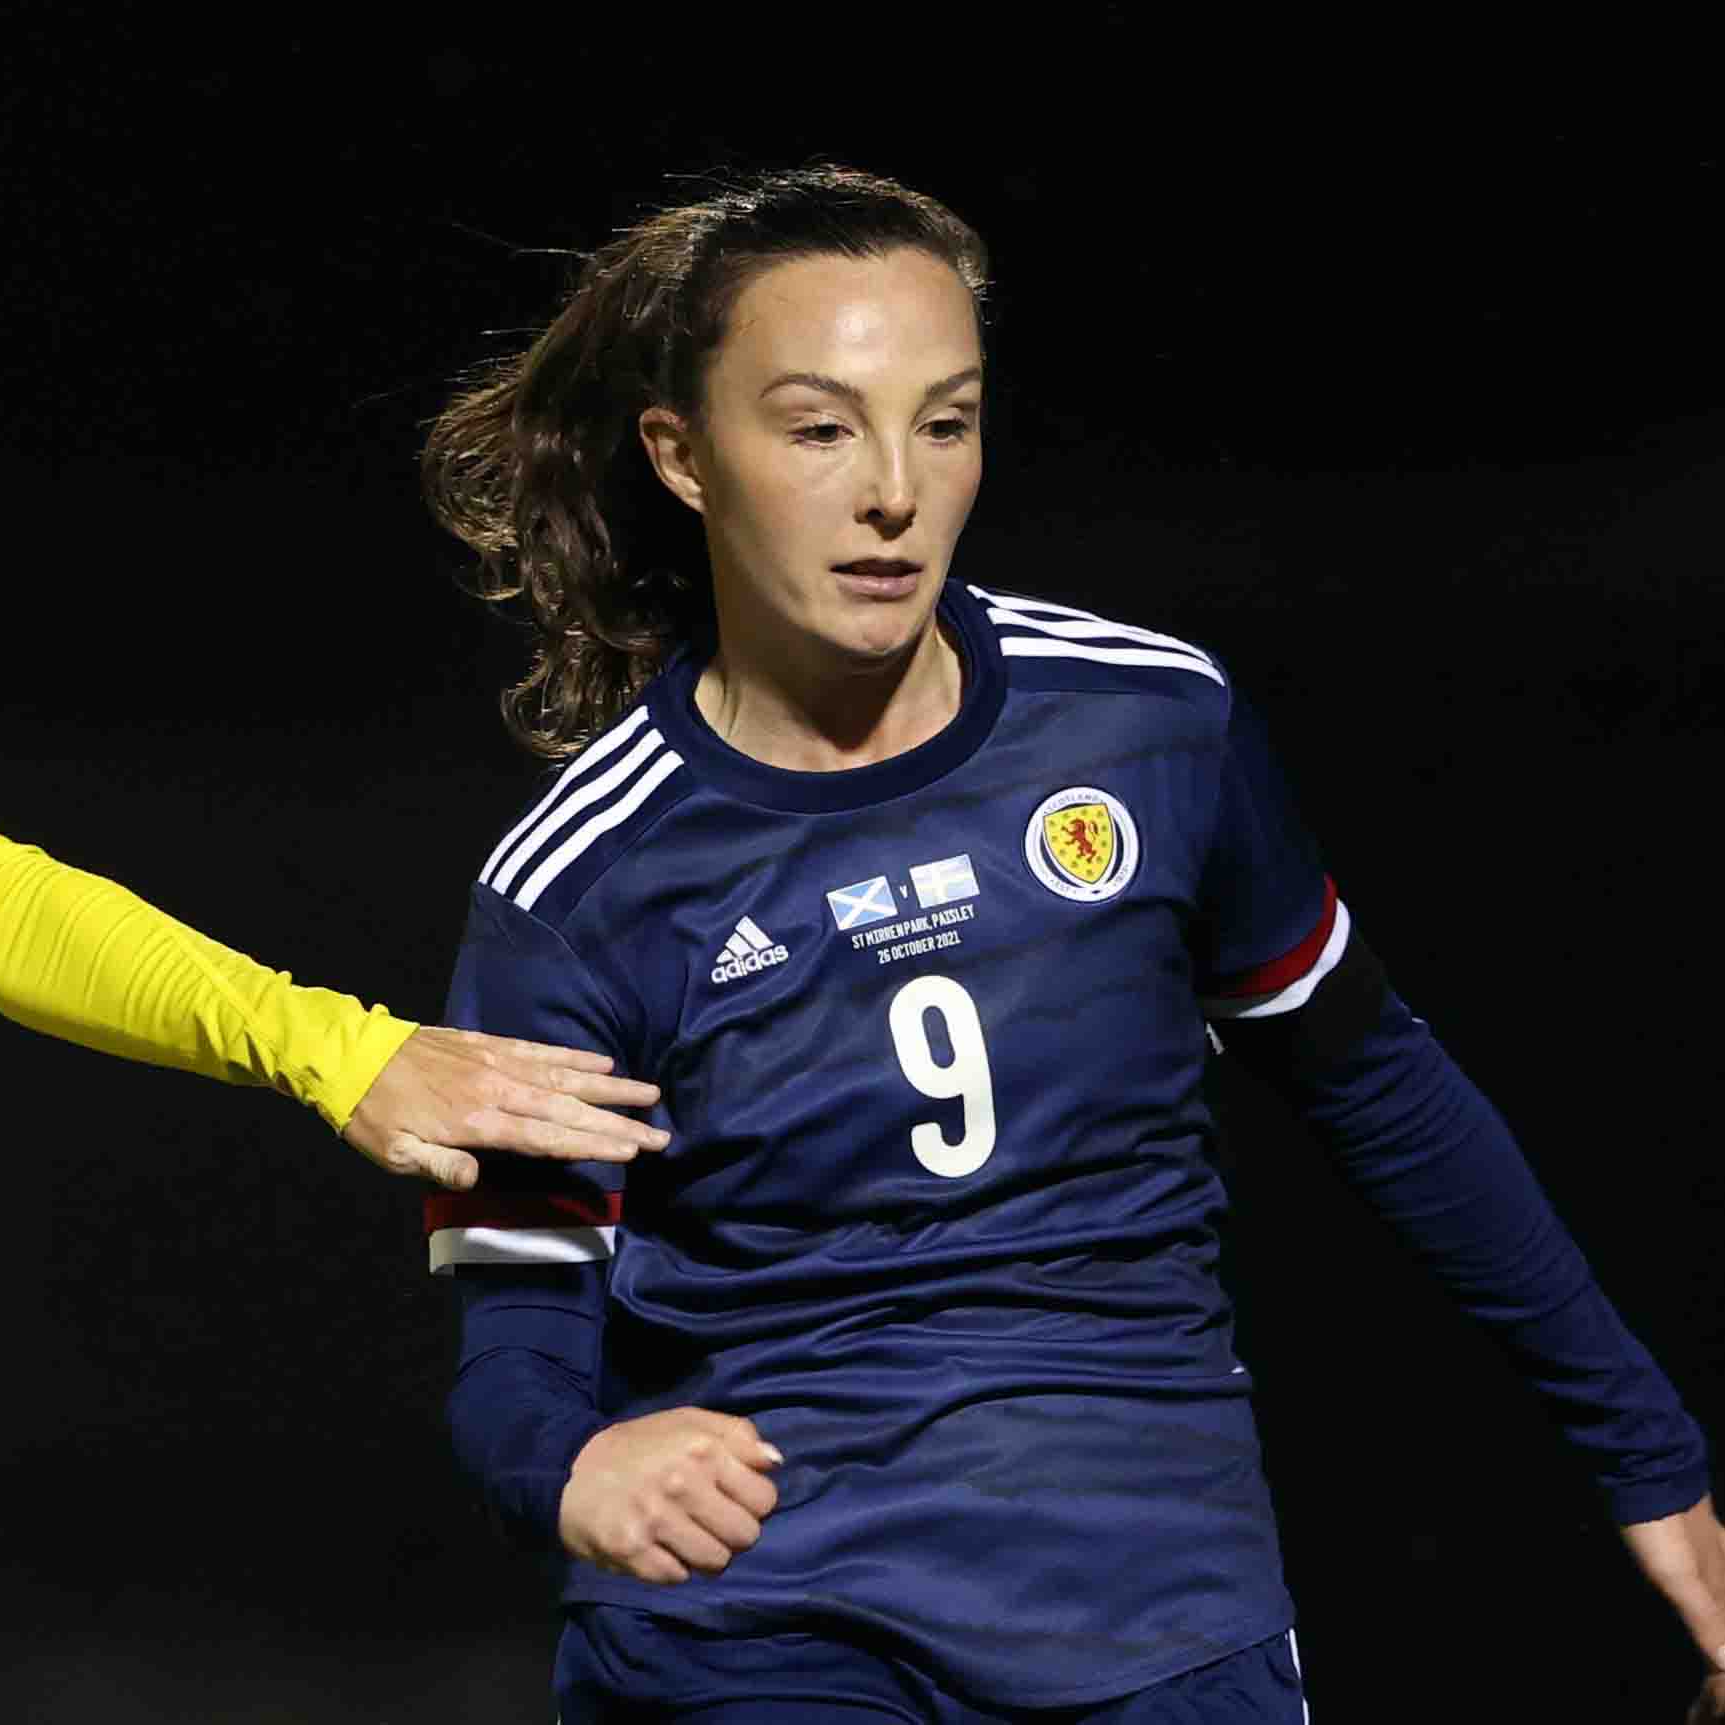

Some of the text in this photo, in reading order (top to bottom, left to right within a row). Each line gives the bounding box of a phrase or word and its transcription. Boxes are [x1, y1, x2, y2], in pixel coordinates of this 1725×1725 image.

[852, 933, 864, 949] ST
[865, 922, 905, 946] MIRREN
[931, 903, 974, 928] PAISLEY
[877, 930, 962, 964] 26 OCTOBER 2021
[711, 944, 789, 984] adidas
[889, 975, 997, 1178] 9
